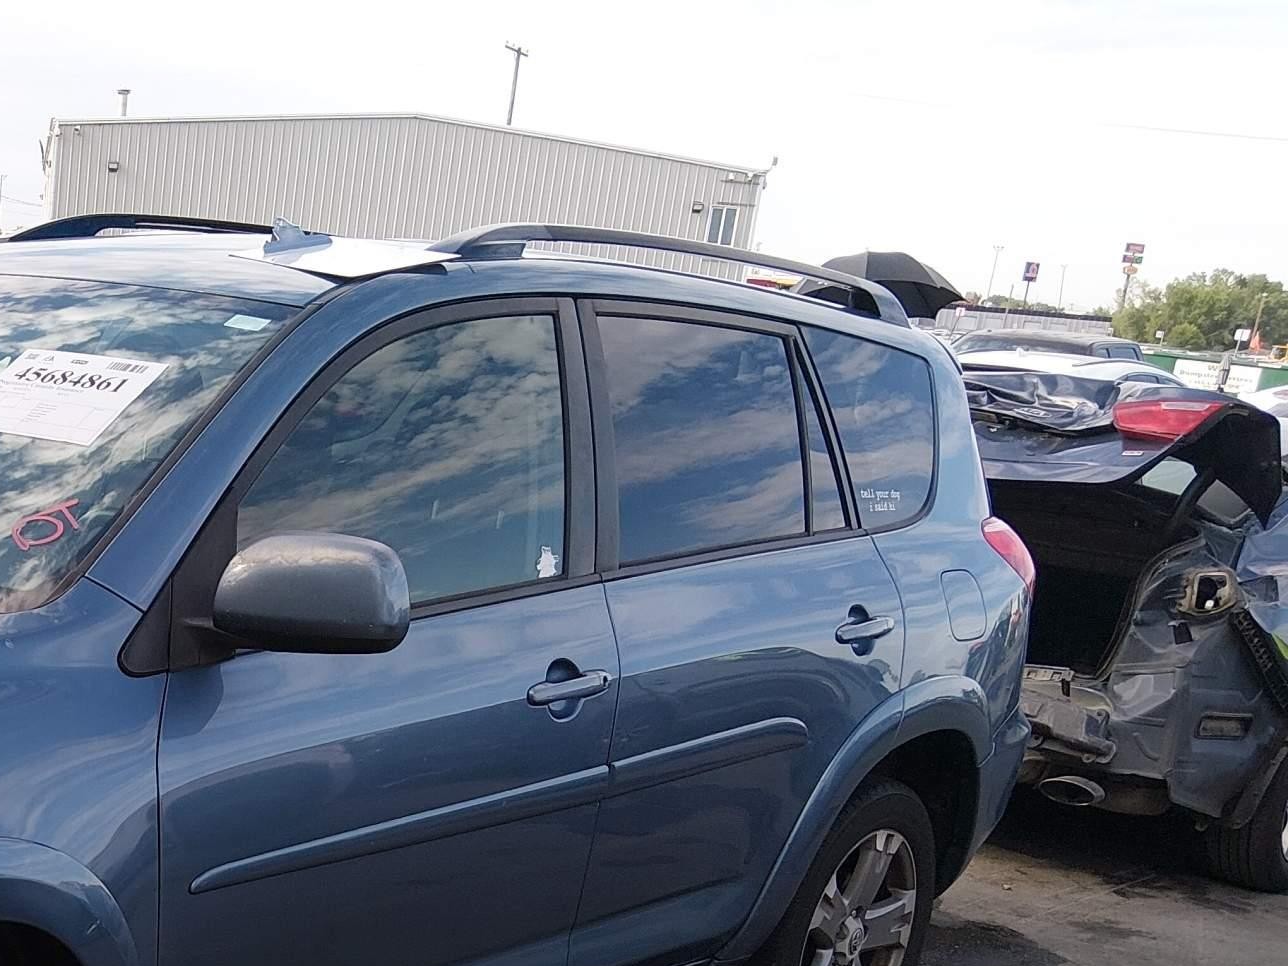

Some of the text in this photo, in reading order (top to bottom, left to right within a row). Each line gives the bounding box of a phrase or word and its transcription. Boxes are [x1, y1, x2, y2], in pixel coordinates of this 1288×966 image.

[14, 366, 129, 393] 45684861
[860, 489, 900, 501] tell your dog
[874, 502, 888, 511] said
